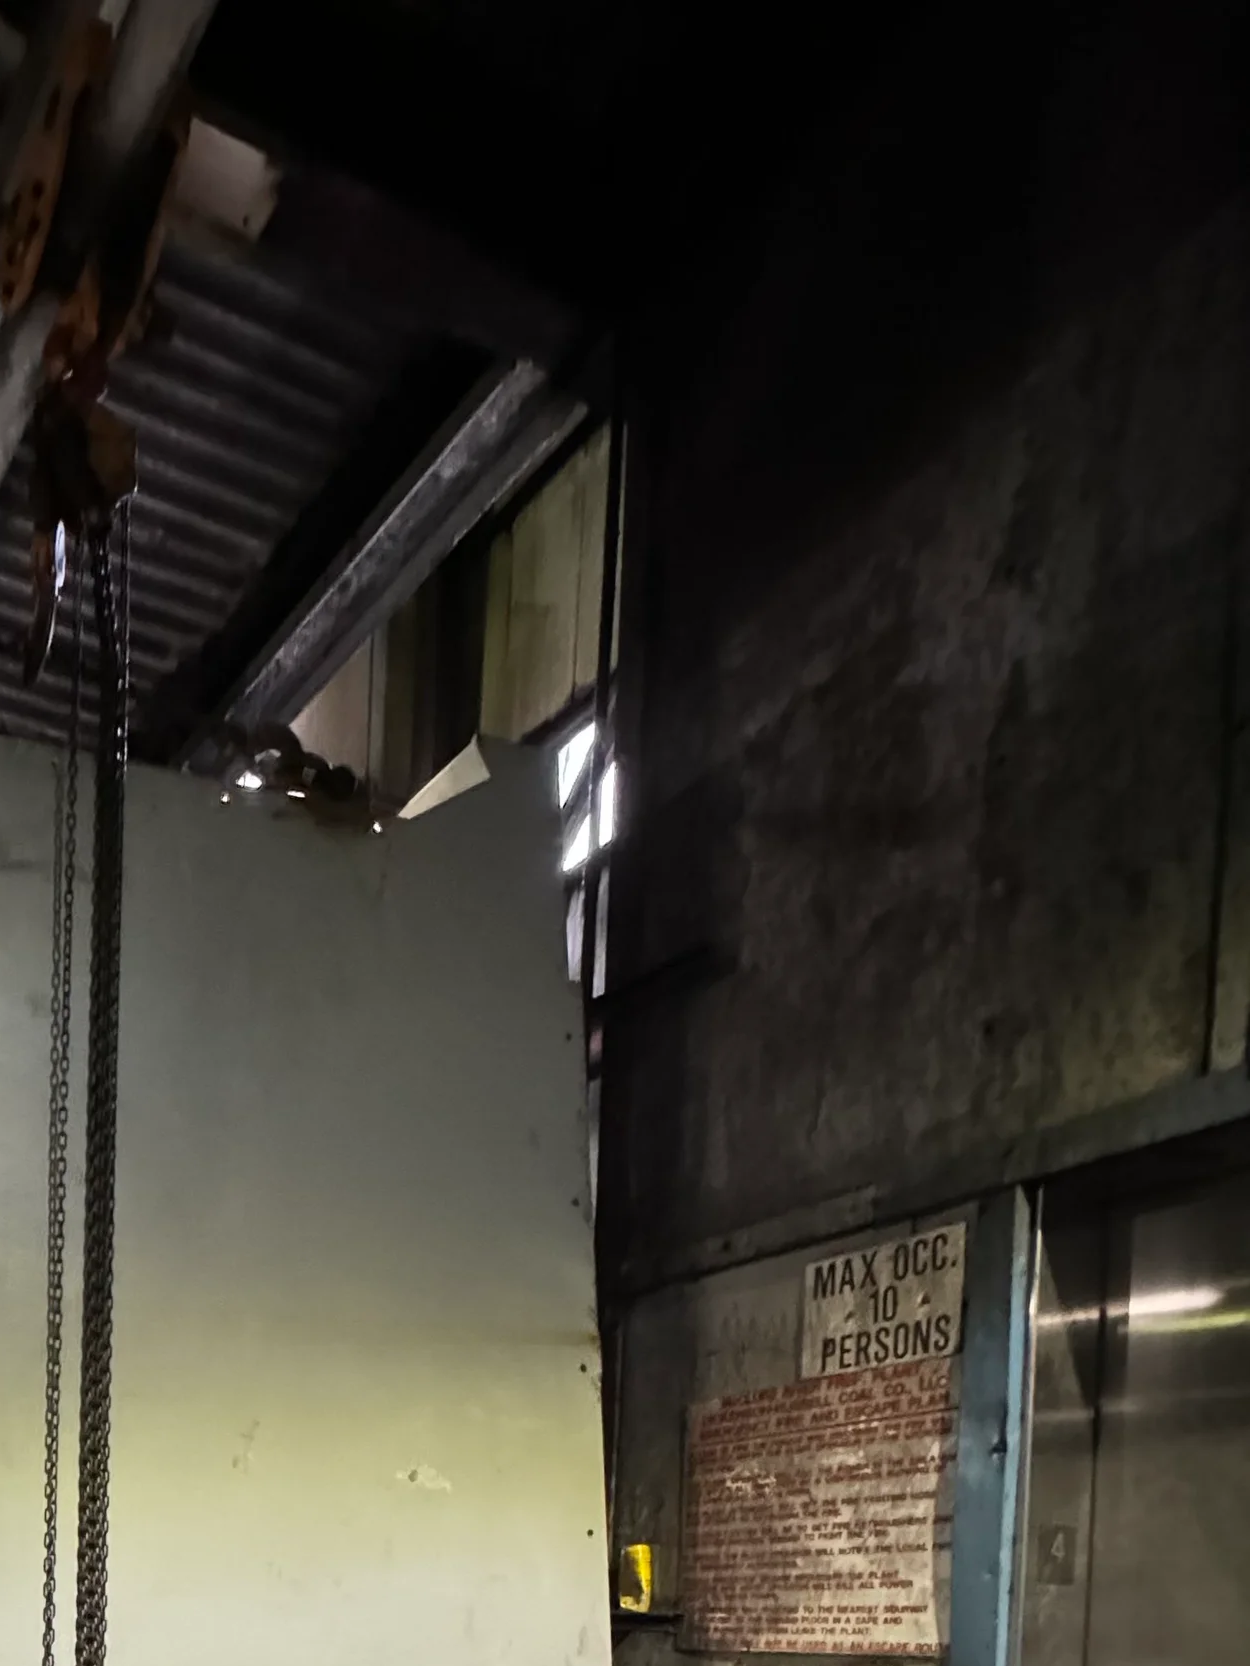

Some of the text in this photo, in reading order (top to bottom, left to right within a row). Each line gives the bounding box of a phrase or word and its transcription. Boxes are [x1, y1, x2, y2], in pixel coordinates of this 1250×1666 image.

[813, 1232, 958, 1301] MAX OCC.
[869, 1285, 899, 1325] 10
[821, 1313, 952, 1374] PERSONS
